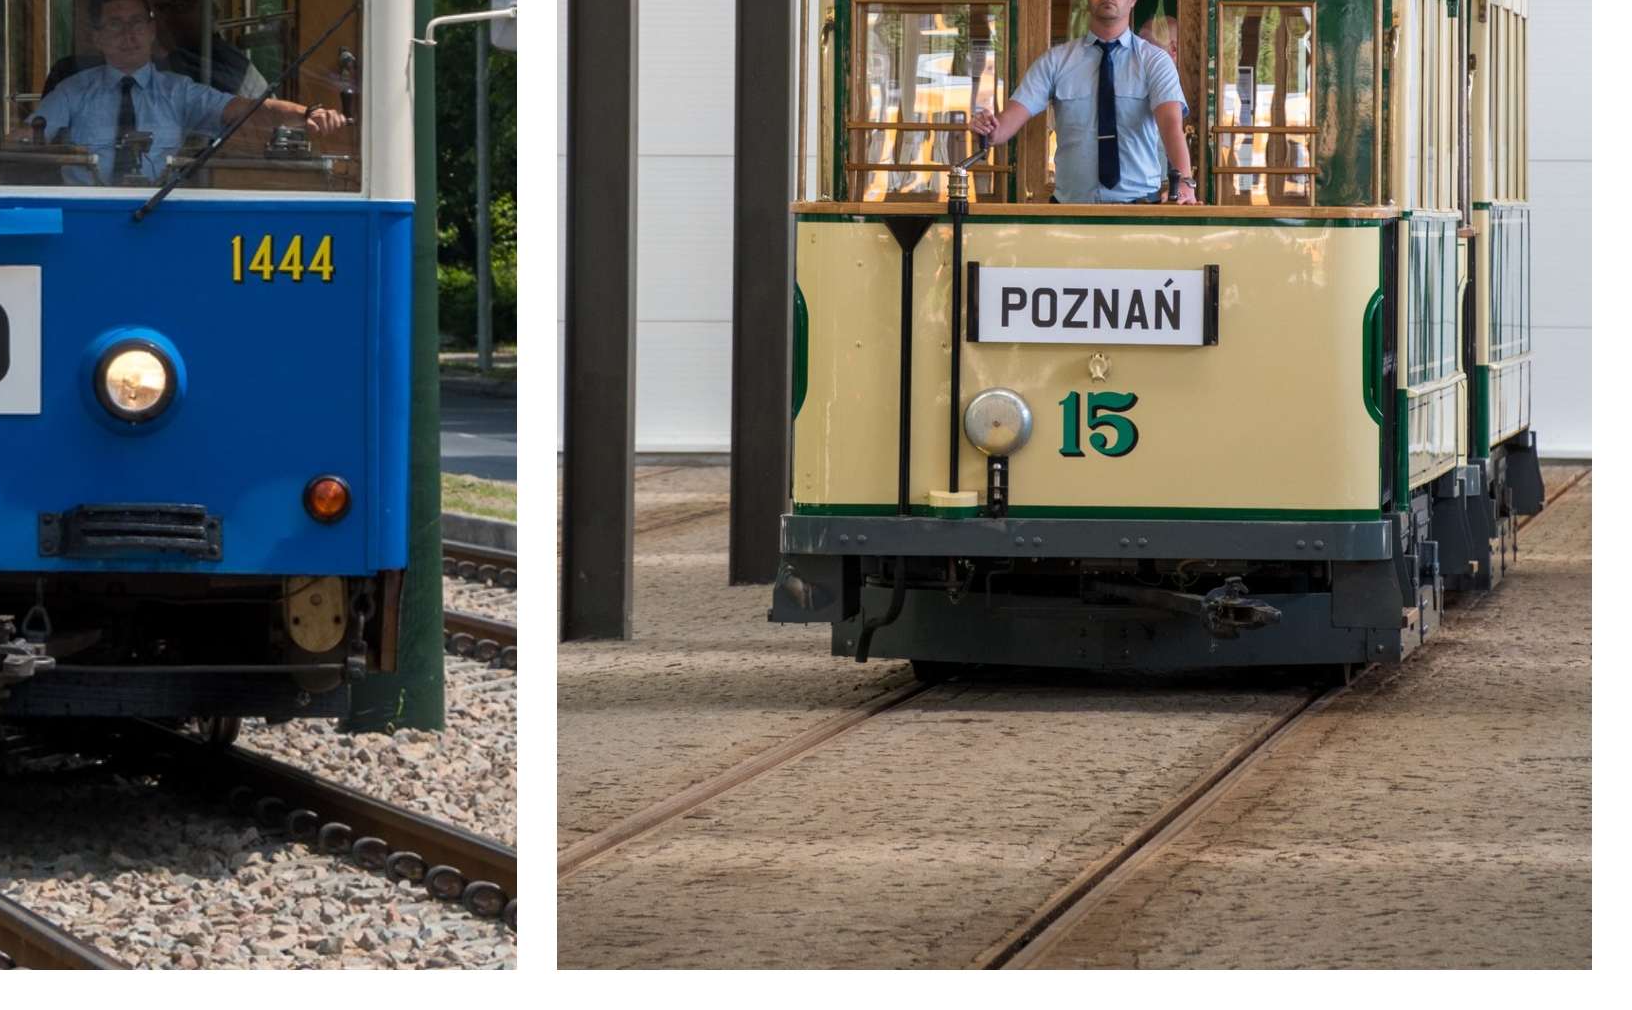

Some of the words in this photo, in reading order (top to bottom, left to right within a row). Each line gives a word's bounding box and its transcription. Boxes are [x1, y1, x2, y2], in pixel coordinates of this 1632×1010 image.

[231, 234, 336, 282] 1444
[1000, 277, 1182, 331] POZNAŃ
[1058, 390, 1141, 459] 15
